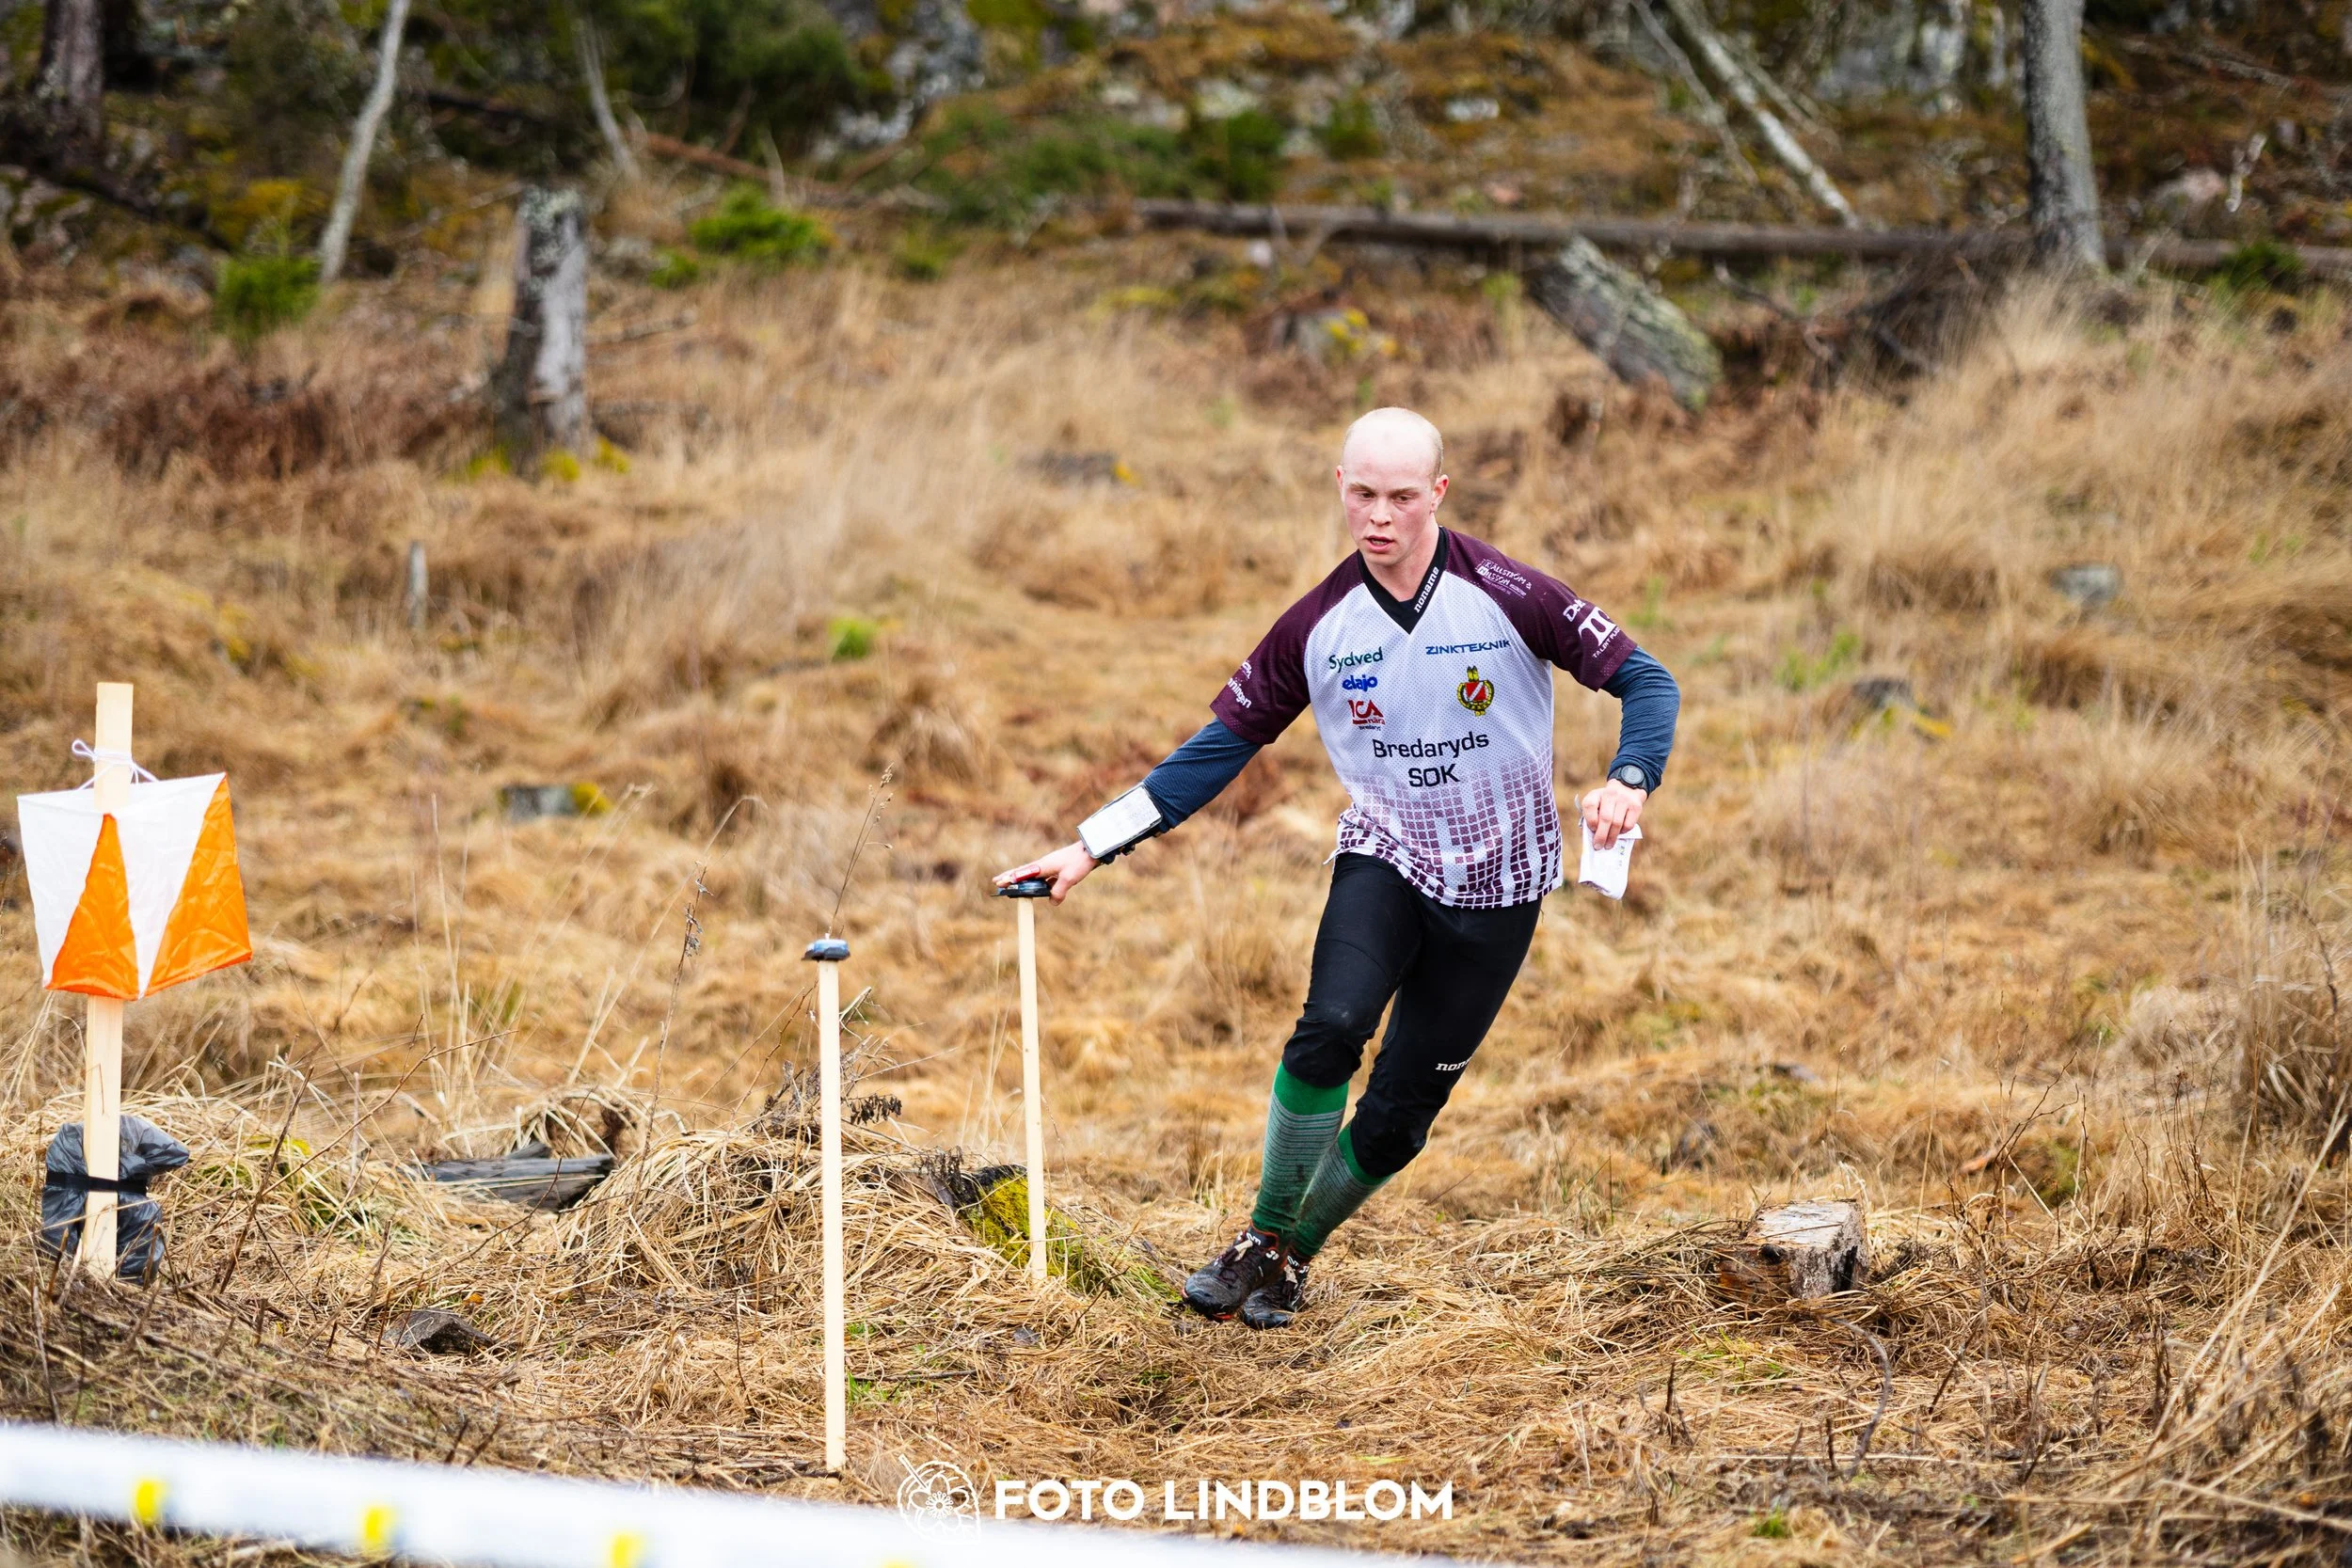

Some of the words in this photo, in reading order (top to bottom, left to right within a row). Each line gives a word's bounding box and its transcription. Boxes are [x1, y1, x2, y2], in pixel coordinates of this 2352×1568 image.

[1414, 566, 1440, 613] noname
[1425, 640, 1511, 655] ZINKTEKNIK
[1328, 646, 1383, 673] Sydved
[1342, 673, 1378, 691] elajo
[1347, 699, 1384, 719] ICA
[1373, 731, 1489, 758] Bredaryds
[1407, 764, 1460, 786] SOK
[1435, 1059, 1469, 1071] non
